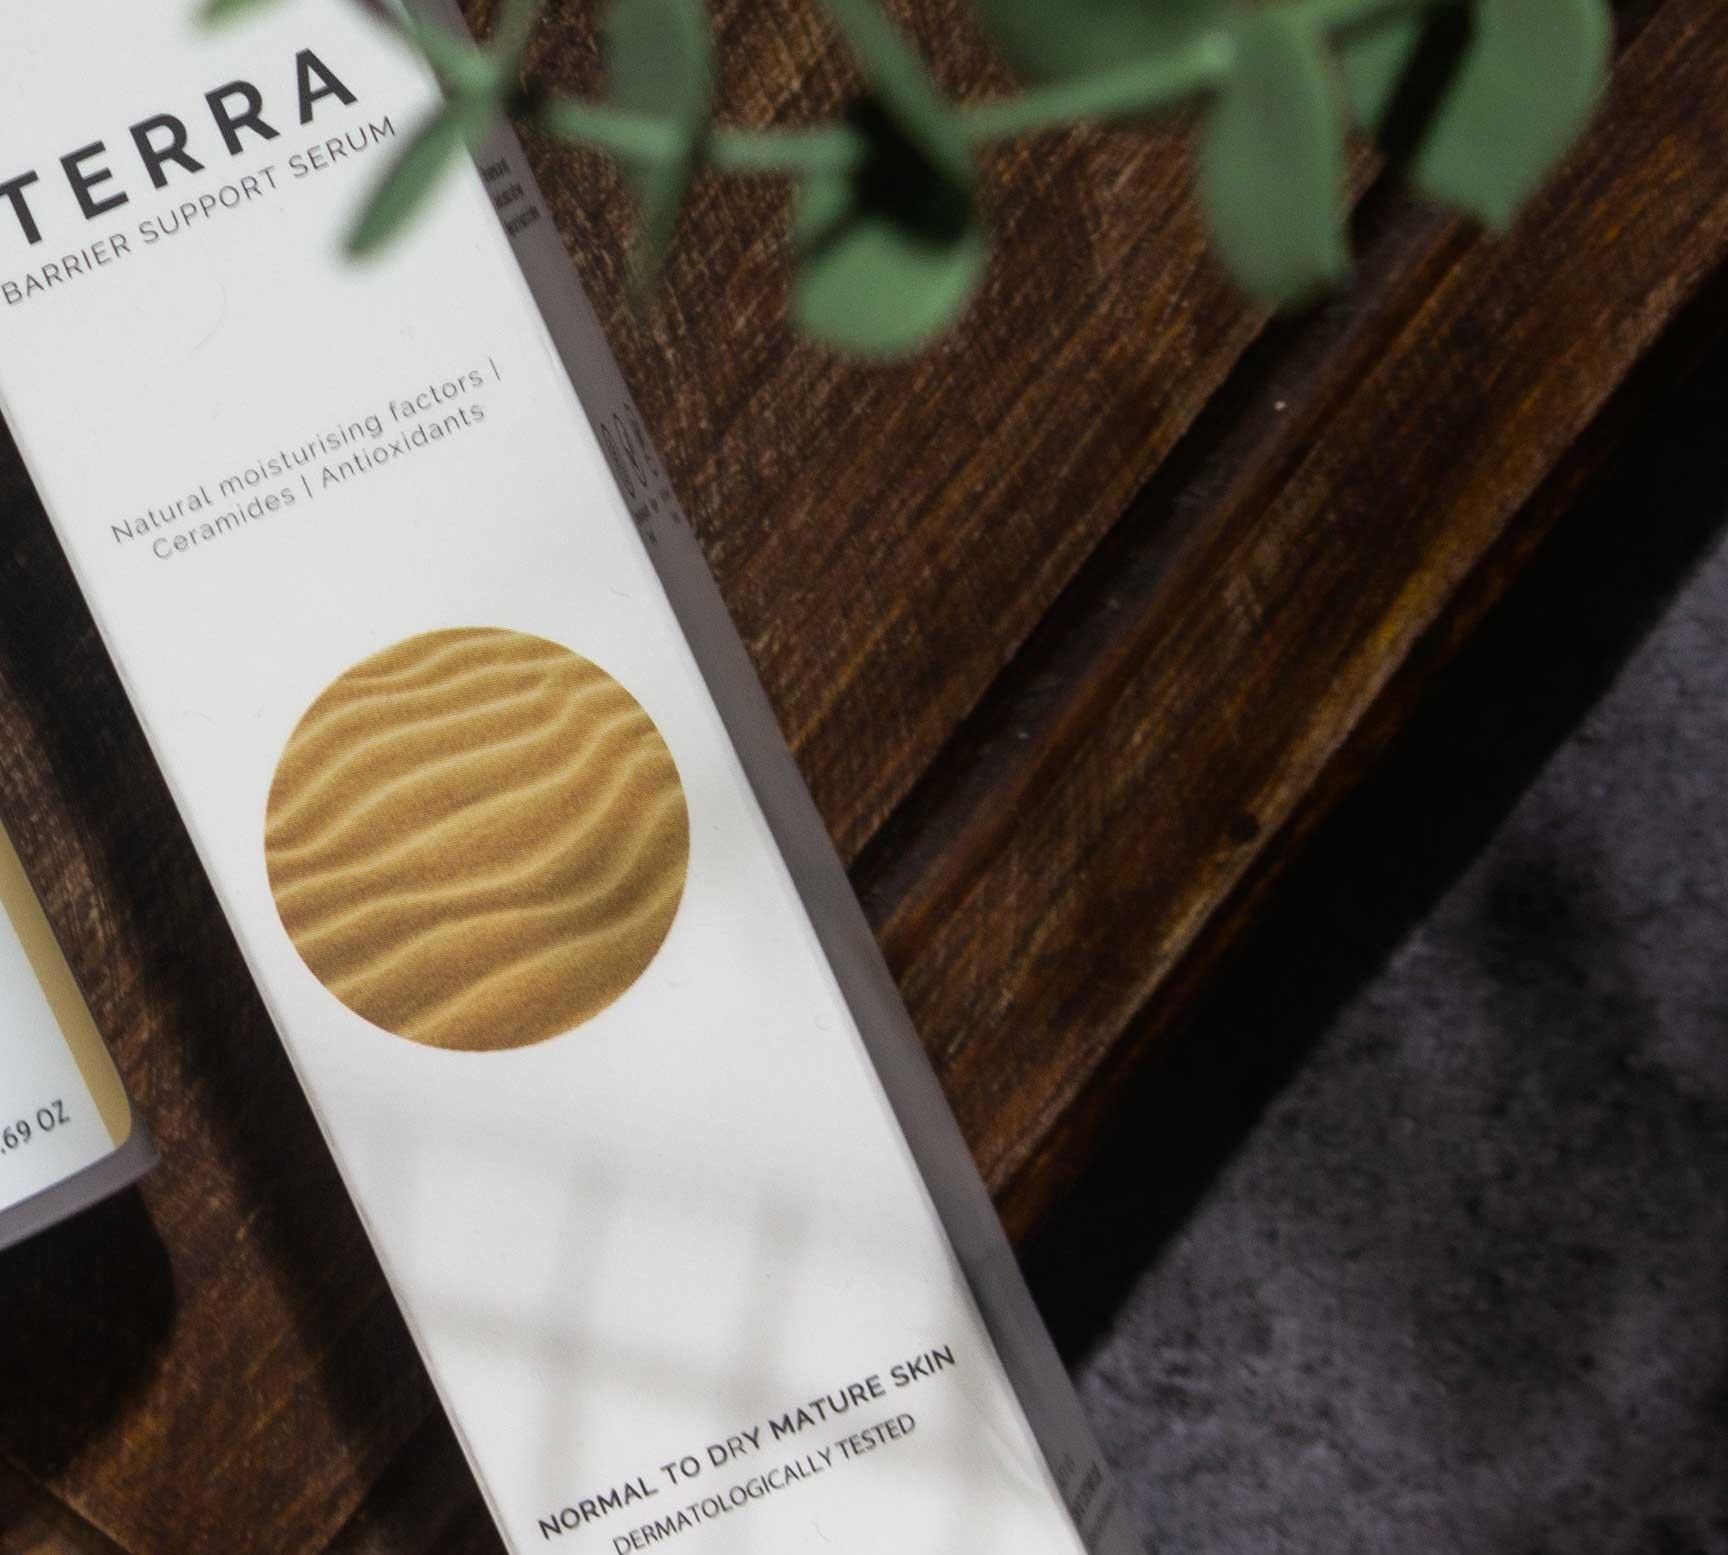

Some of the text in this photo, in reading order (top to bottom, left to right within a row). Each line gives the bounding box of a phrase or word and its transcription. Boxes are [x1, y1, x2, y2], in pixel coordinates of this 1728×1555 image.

[1, 116, 397, 305] BARRIER SUPPORT SERUM
[111, 486, 211, 543] Natural
[219, 415, 383, 495] moisturising
[389, 369, 484, 422] factors
[153, 488, 295, 558] Ceramides
[323, 405, 484, 487] Antioxidants
[37, 1100, 70, 1131] OZ
[538, 1345, 956, 1540] NORMAL TO DRY MATURE SKIN
[613, 1414, 915, 1555] DERMATOLOGICALLY TESTED
